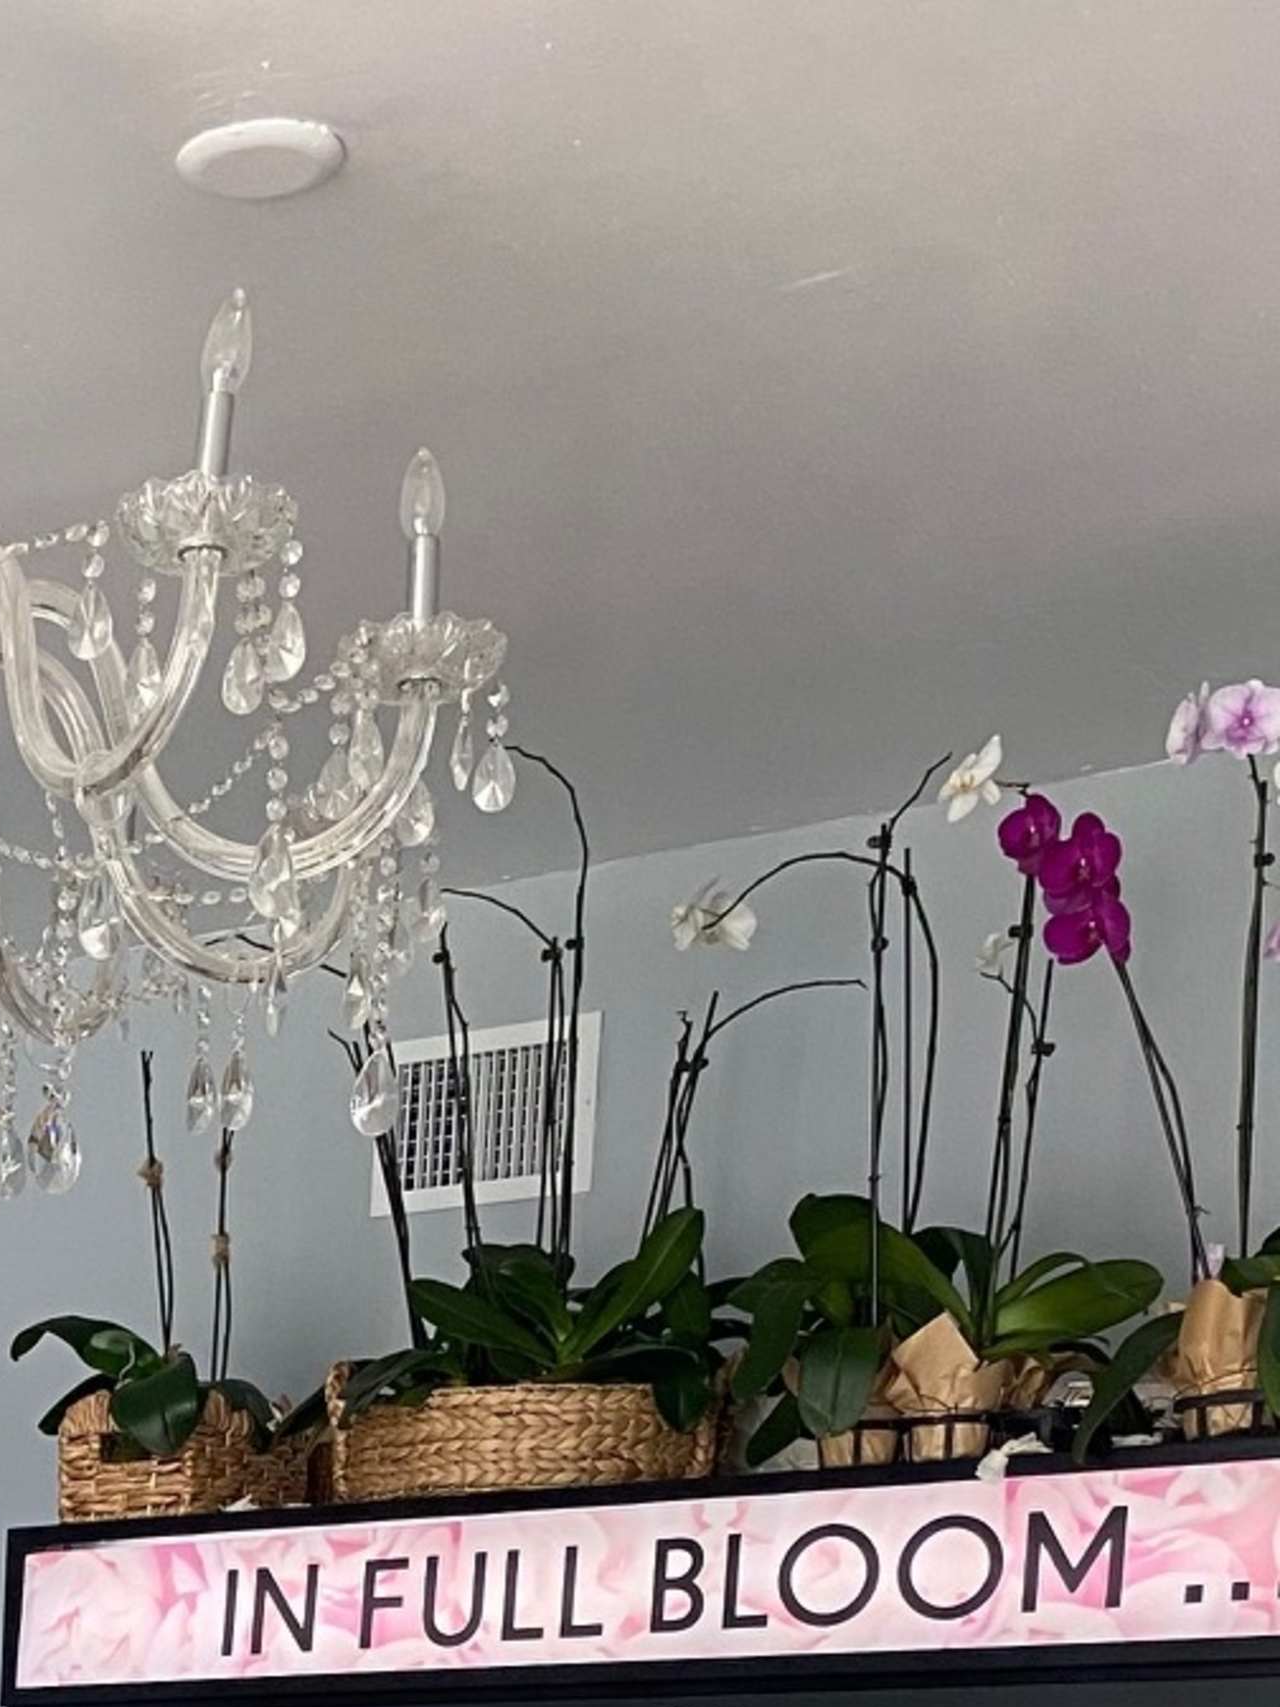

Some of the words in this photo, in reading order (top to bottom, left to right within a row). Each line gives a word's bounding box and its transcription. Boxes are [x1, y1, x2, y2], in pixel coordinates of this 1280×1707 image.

[220, 1563, 320, 1658] IN
[358, 1545, 604, 1650] FULL
[648, 1504, 1130, 1635] BLOOM
